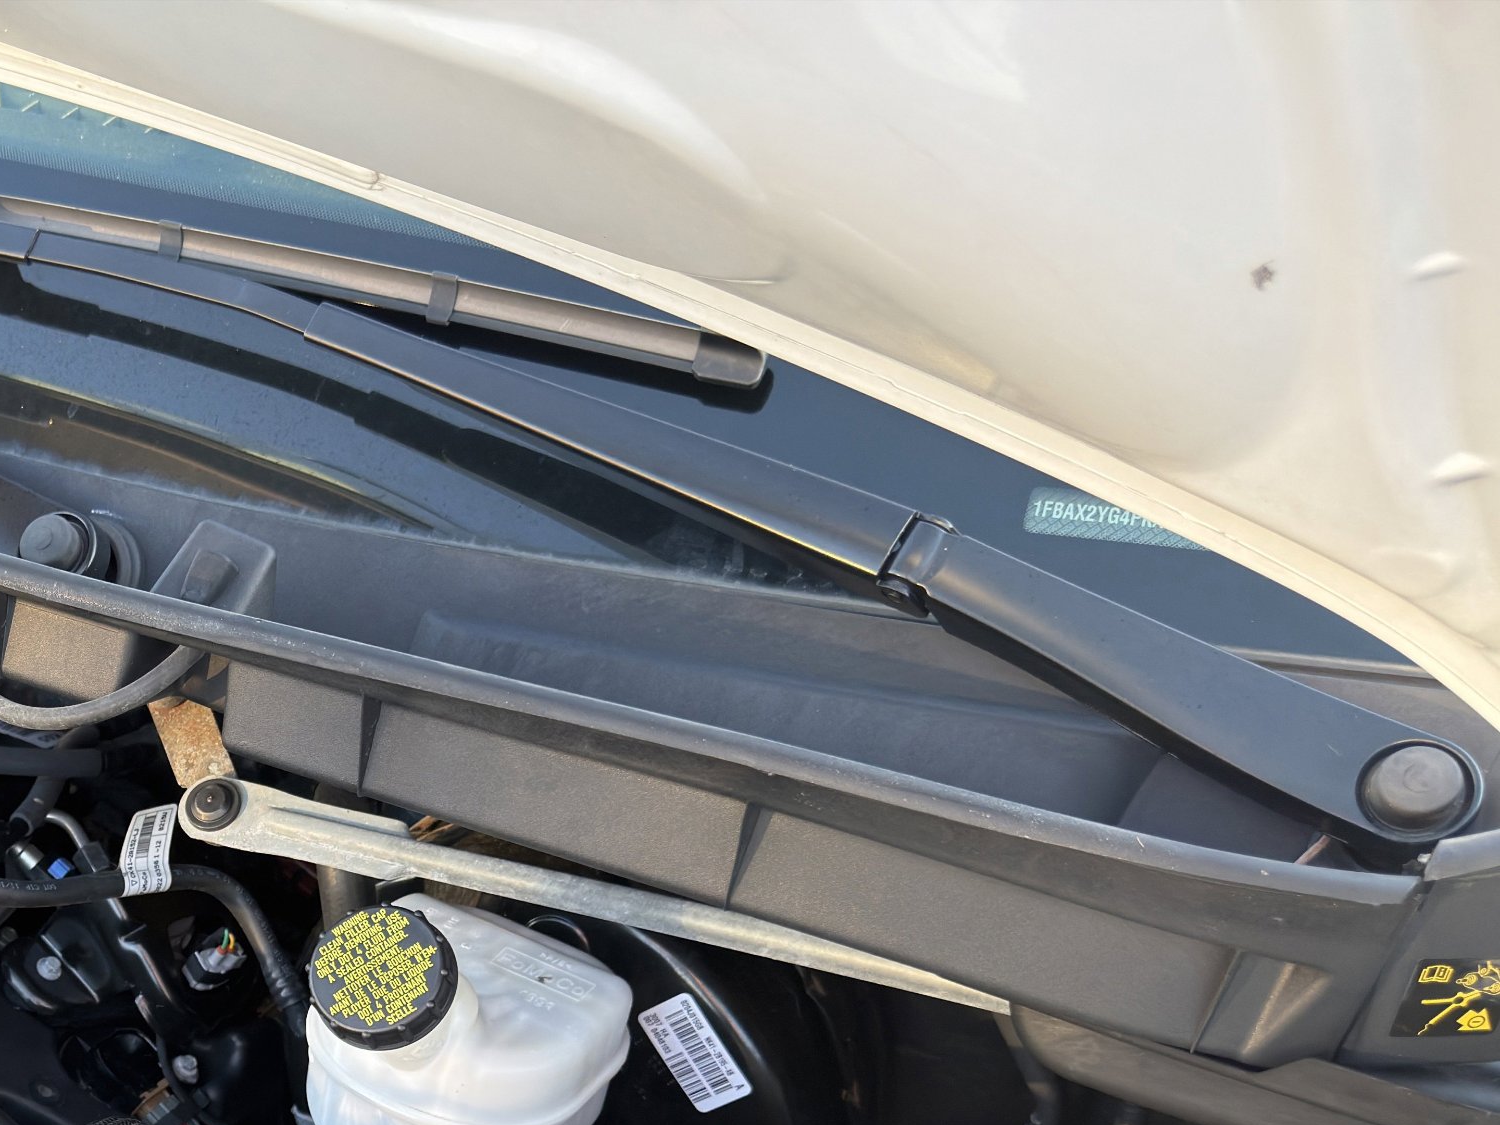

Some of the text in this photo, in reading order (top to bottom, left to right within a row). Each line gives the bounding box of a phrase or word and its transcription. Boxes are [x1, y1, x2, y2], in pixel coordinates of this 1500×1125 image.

[314, 910, 402, 969] BEFORE REMOVING. USE
[316, 916, 409, 978] ONLY DOT 4 FLUID FROM
[318, 908, 386, 956] CLEAN FILLER CAP
[331, 911, 369, 936] WARNING:
[327, 930, 407, 983] A SEALED CONTAINER.
[333, 942, 422, 1001] NETTOYER LE BOUCHON
[343, 945, 402, 984] AVERTISSEMENT:
[329, 995, 352, 1015] AVANT
[353, 987, 366, 1000] DE
[366, 979, 378, 992] LE
[341, 957, 433, 1017] PLOYER QUE DU LIQUIDE
[356, 972, 426, 1019] DOT 4 PROVENANT
[364, 982, 428, 1026] D'UN CONTENANT
